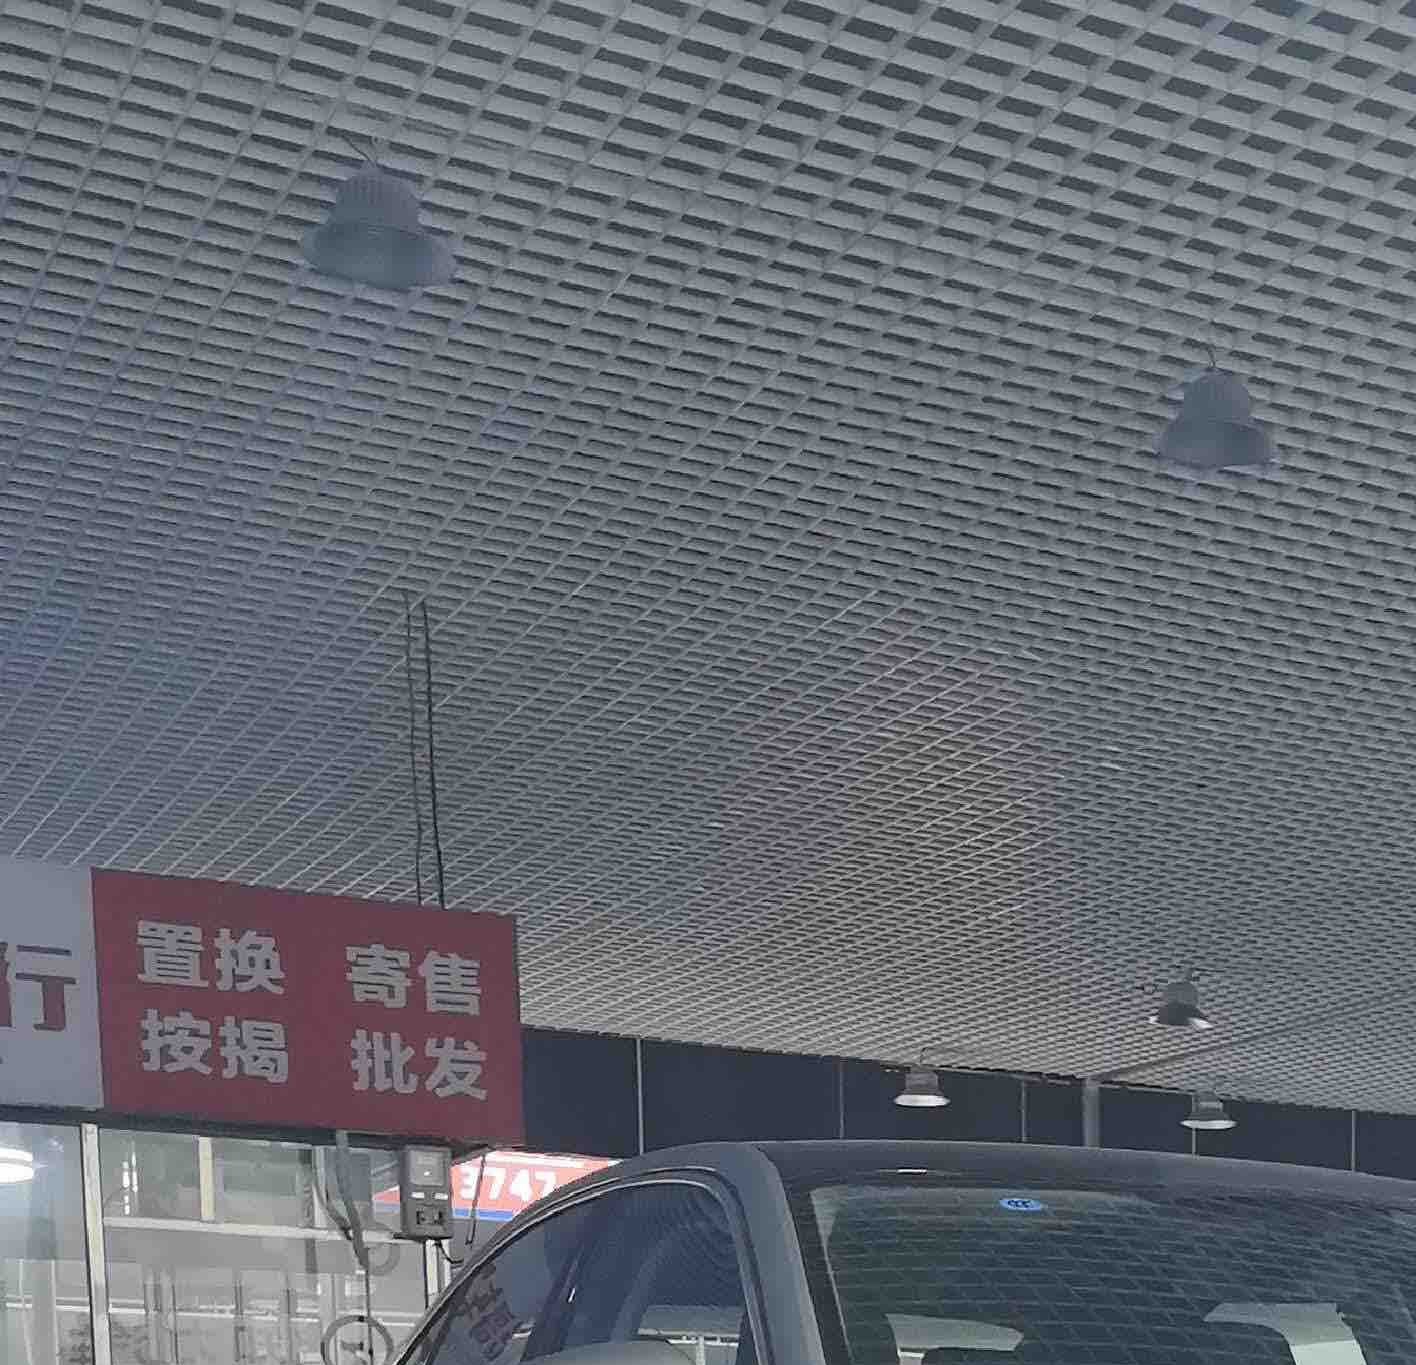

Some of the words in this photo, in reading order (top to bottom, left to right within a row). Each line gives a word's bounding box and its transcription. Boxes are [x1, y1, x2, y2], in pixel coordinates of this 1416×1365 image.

[136, 919, 286, 997] 置换
[345, 944, 483, 1017] 寄售
[139, 1008, 289, 1084] 按揭
[350, 1029, 488, 1101] 批发
